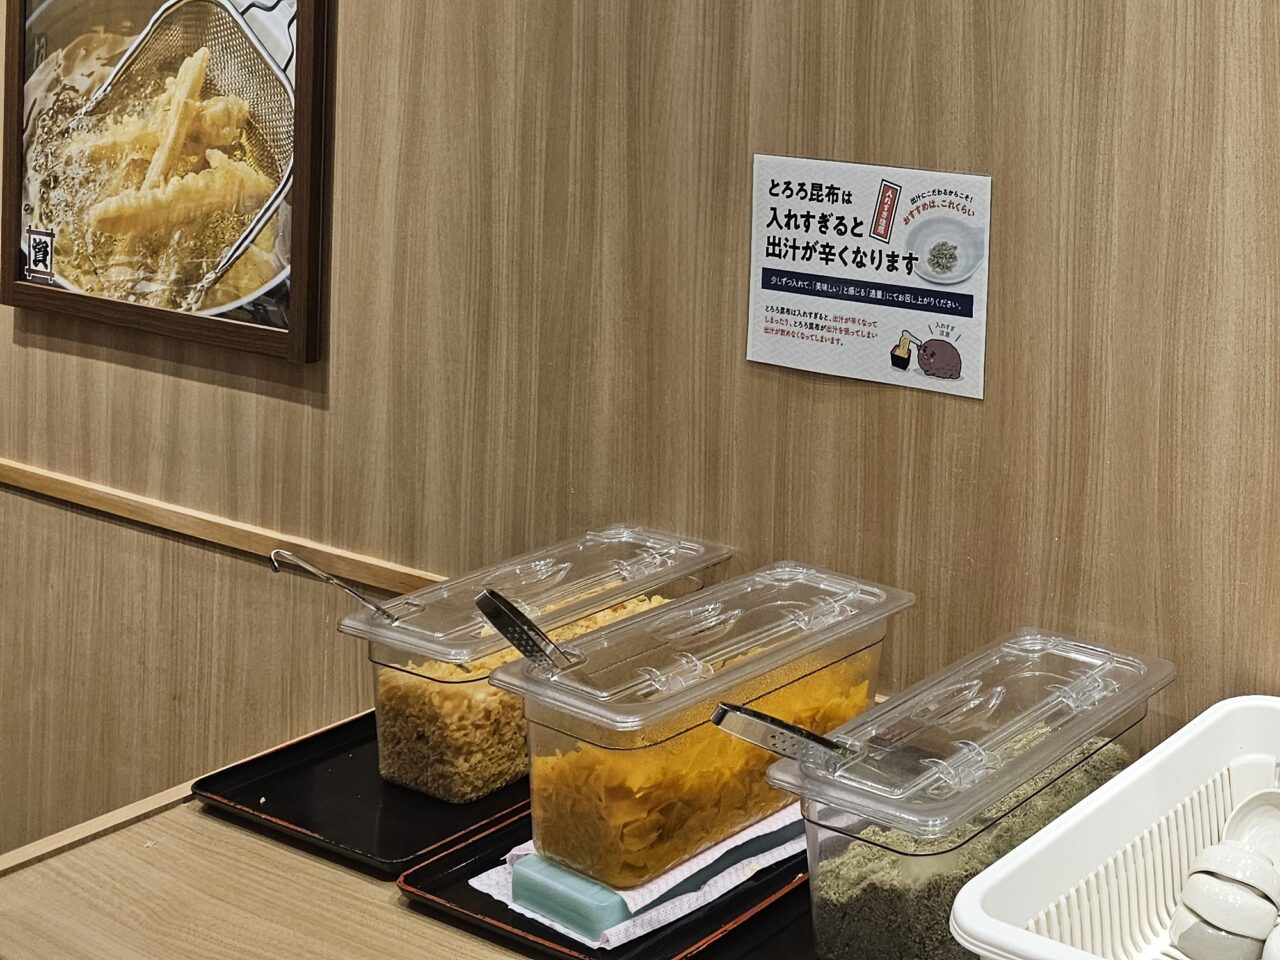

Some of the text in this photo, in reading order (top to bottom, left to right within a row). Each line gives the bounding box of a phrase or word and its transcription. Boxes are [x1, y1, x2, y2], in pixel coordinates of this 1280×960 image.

[768, 179, 852, 205] とろろ昆布は
[766, 208, 864, 238] 入れすぎると
[765, 236, 919, 275] 出汁が辛くなります
